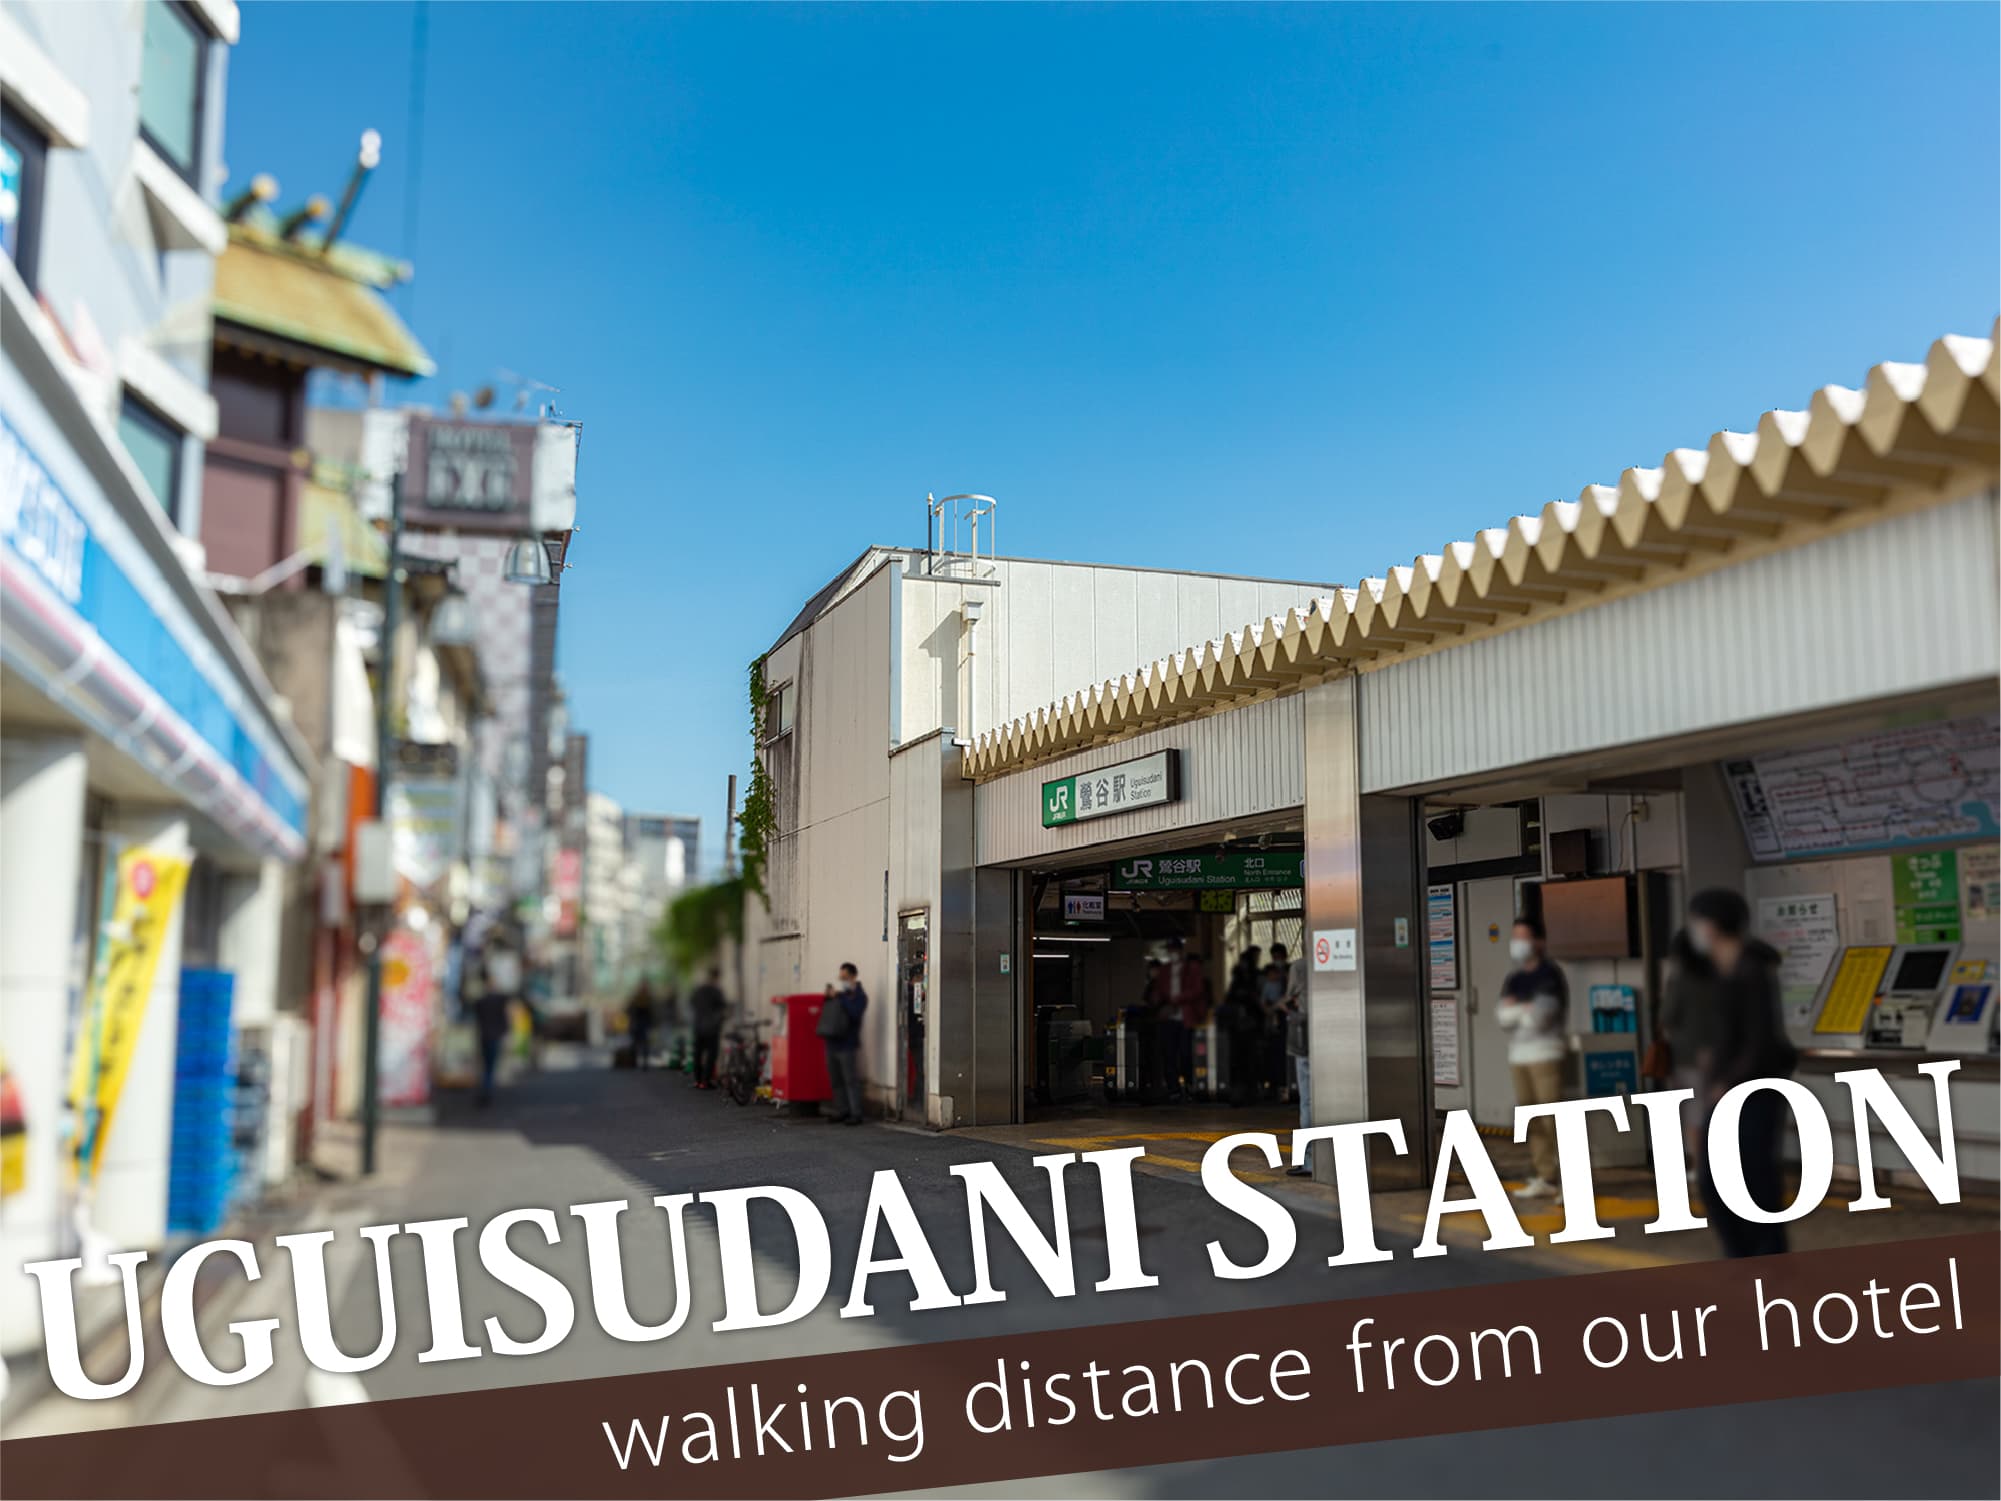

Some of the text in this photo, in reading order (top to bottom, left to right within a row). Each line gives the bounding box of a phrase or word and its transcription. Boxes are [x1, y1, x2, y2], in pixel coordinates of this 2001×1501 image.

[1130, 772, 1162, 788] Uguisudani
[1050, 786, 1068, 812] JR
[1079, 773, 1126, 812] 鶯谷駅
[1130, 788, 1152, 801] Station
[1121, 860, 1153, 878] JR
[1158, 859, 1201, 874] 鶯谷駅
[1244, 857, 1265, 868] 北口
[1158, 875, 1205, 886] Uguisudani
[1206, 874, 1236, 884] Station
